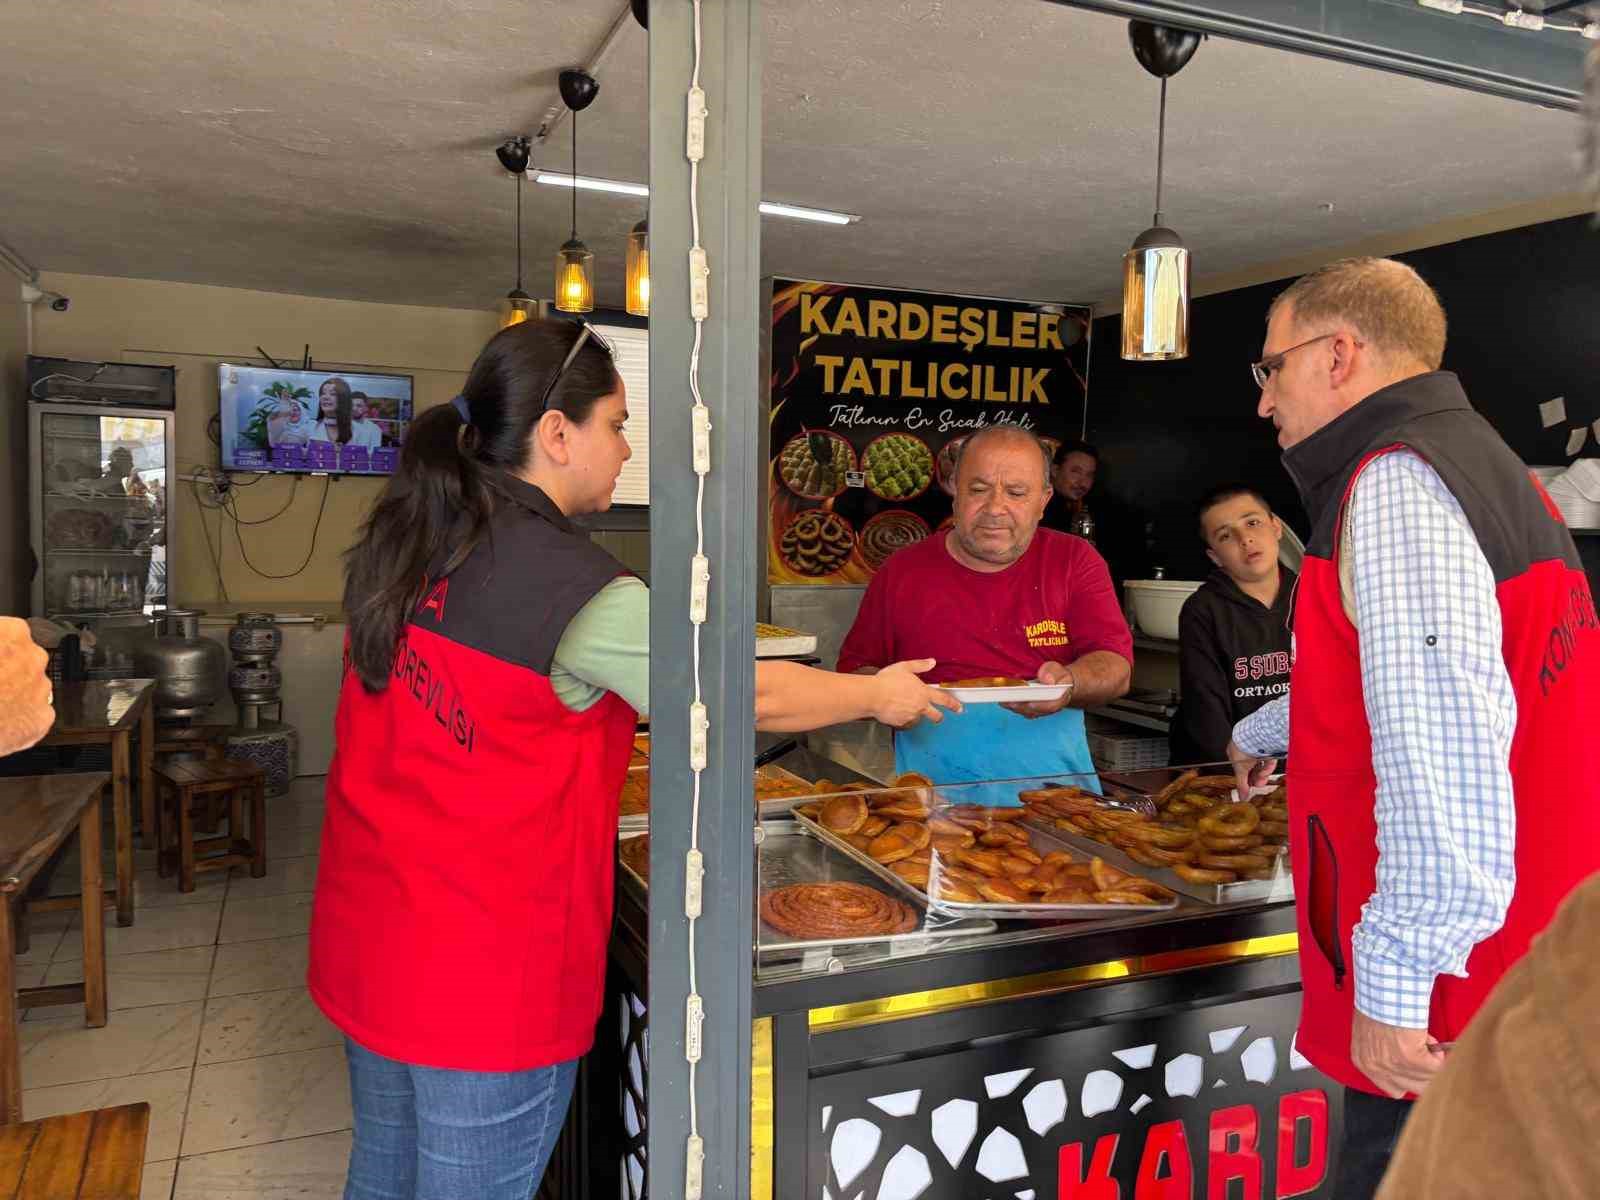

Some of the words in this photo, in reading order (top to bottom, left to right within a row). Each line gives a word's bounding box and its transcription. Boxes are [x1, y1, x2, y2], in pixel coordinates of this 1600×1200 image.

[800, 293, 1064, 352] KARDEŞLER
[815, 355, 1051, 405] TATLICILIK
[904, 407, 934, 430] En
[938, 409, 989, 433] Sıcak
[1058, 1089, 1329, 1200] KARD
